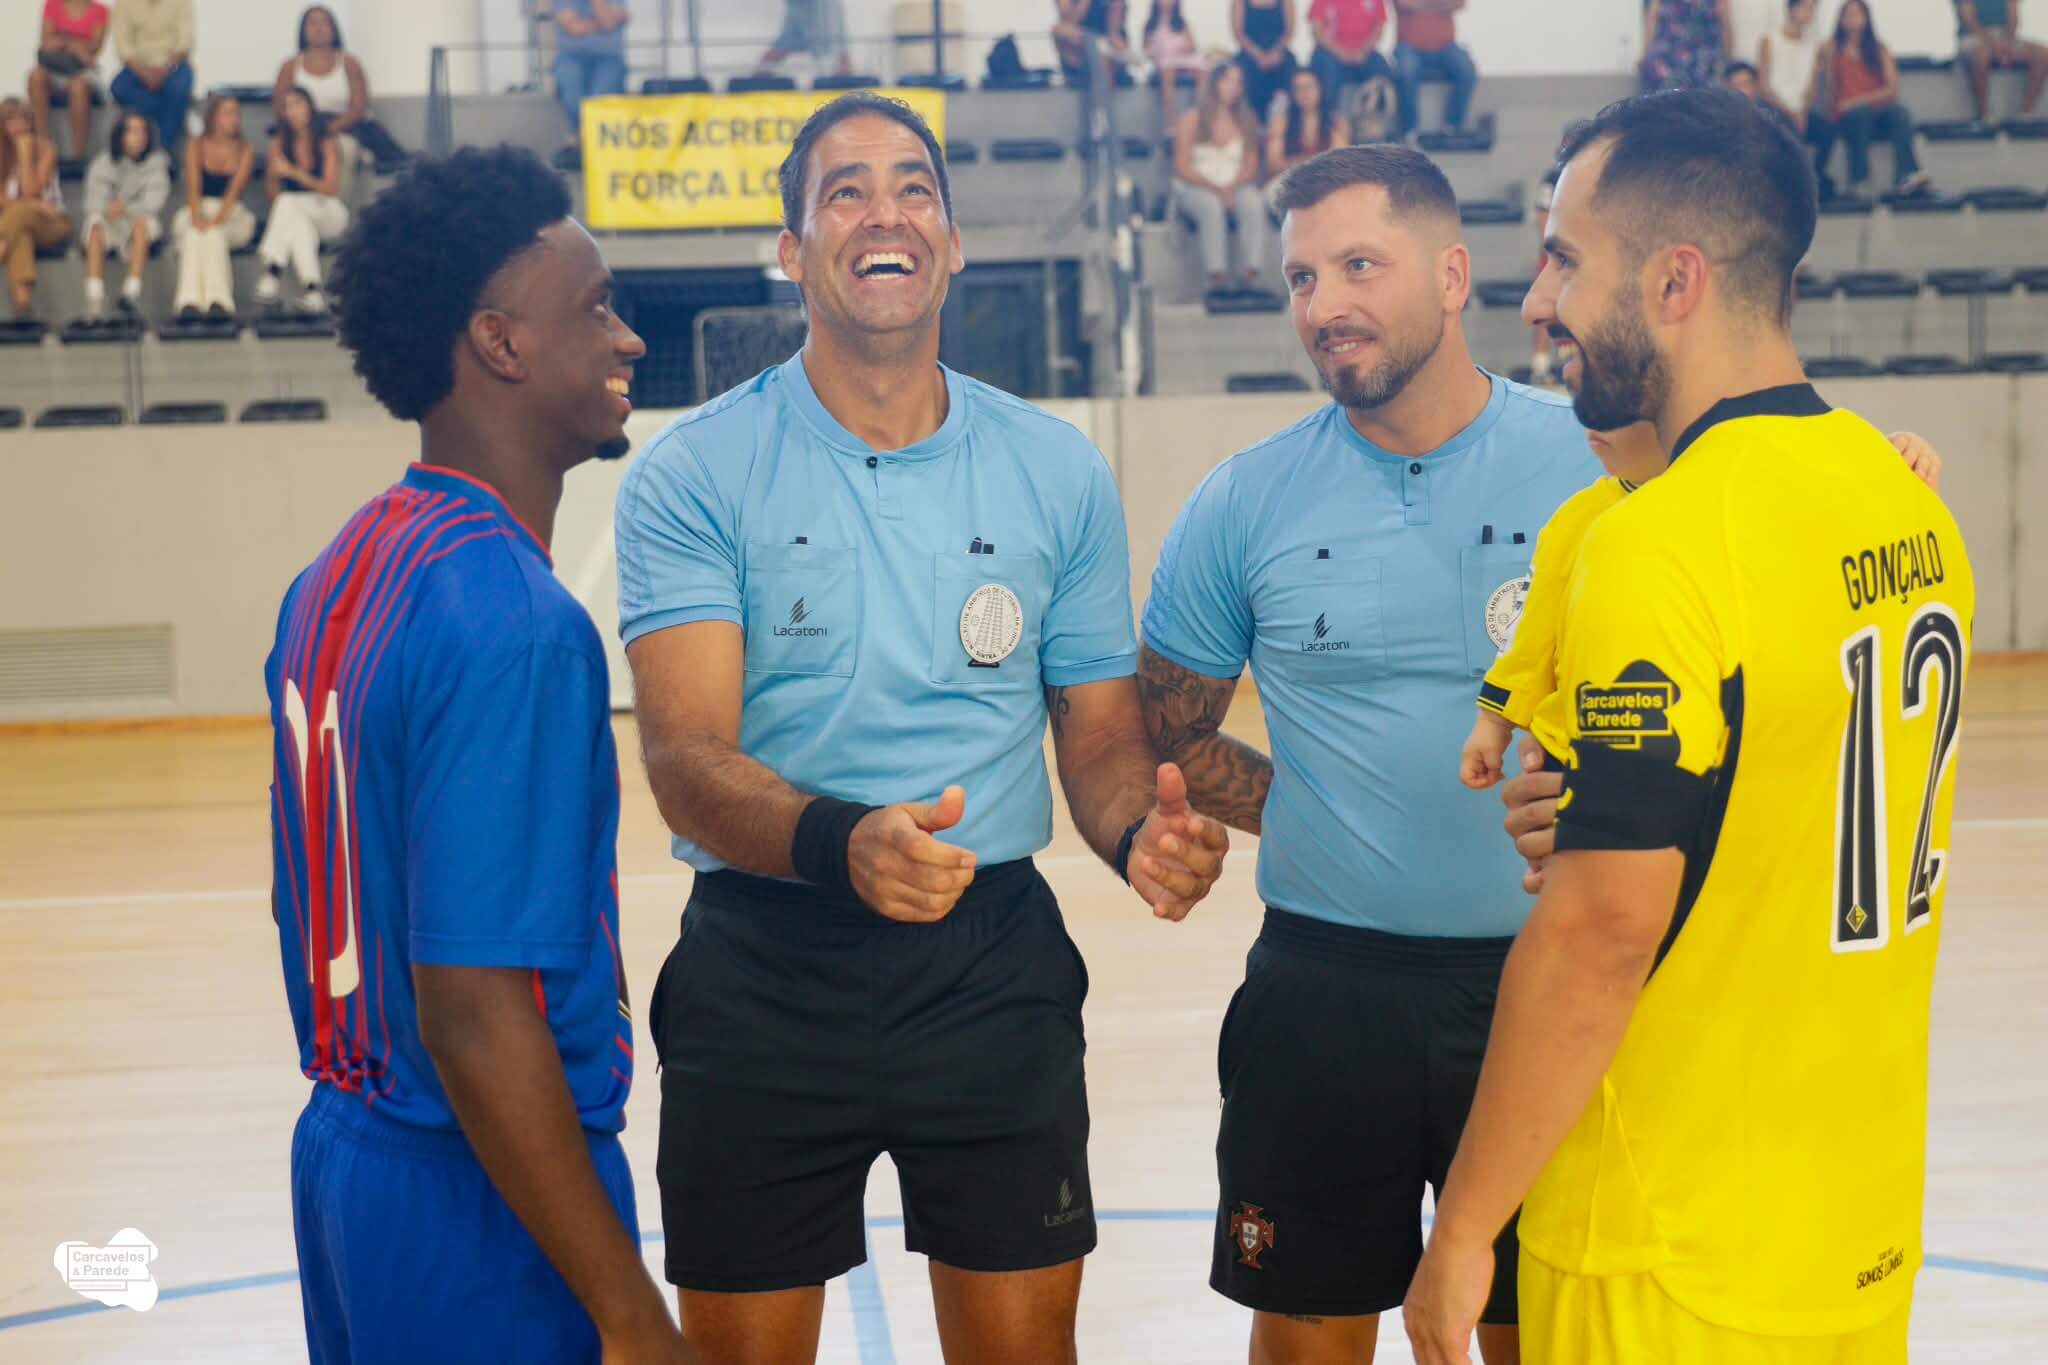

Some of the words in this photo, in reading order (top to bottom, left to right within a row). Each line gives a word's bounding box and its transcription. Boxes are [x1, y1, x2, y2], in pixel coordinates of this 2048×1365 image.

[598, 118, 669, 149] NÓS
[681, 115, 804, 148] ACRED
[608, 169, 729, 205] FORÇA
[740, 166, 781, 197] LO
[1841, 529, 1944, 611] GONÇALO
[773, 624, 828, 637] Lacatoni
[1301, 639, 1350, 652] Lacatoni
[1581, 692, 1663, 709] arcavelos
[1586, 710, 1642, 728] Parede
[1830, 601, 1964, 953] 12
